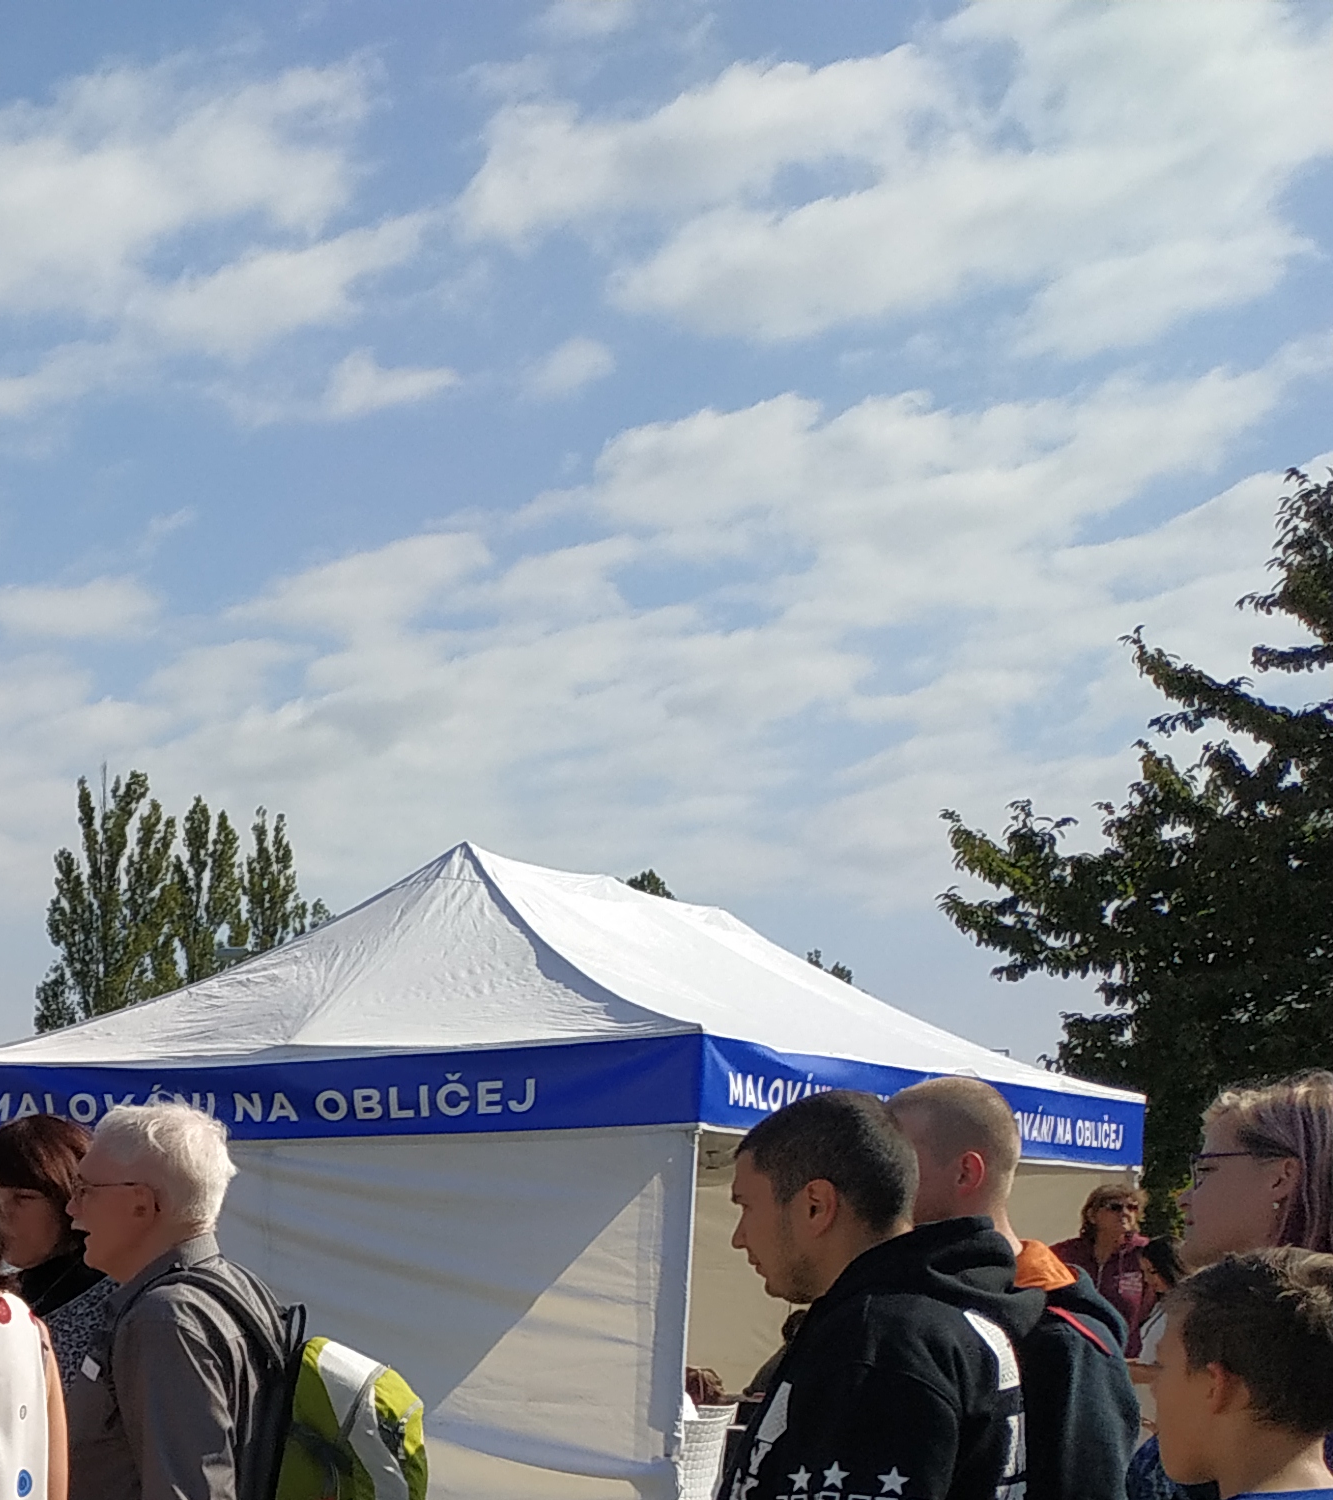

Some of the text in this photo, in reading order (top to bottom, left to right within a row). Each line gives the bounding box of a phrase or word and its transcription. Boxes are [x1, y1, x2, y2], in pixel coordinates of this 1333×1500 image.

[233, 1092, 299, 1122] NA
[315, 1072, 536, 1121] OBLIČEJ
[728, 1071, 832, 1112] MALOVÁ
[1054, 1117, 1073, 1145] NA
[1075, 1114, 1124, 1150] OBLIČEJ
